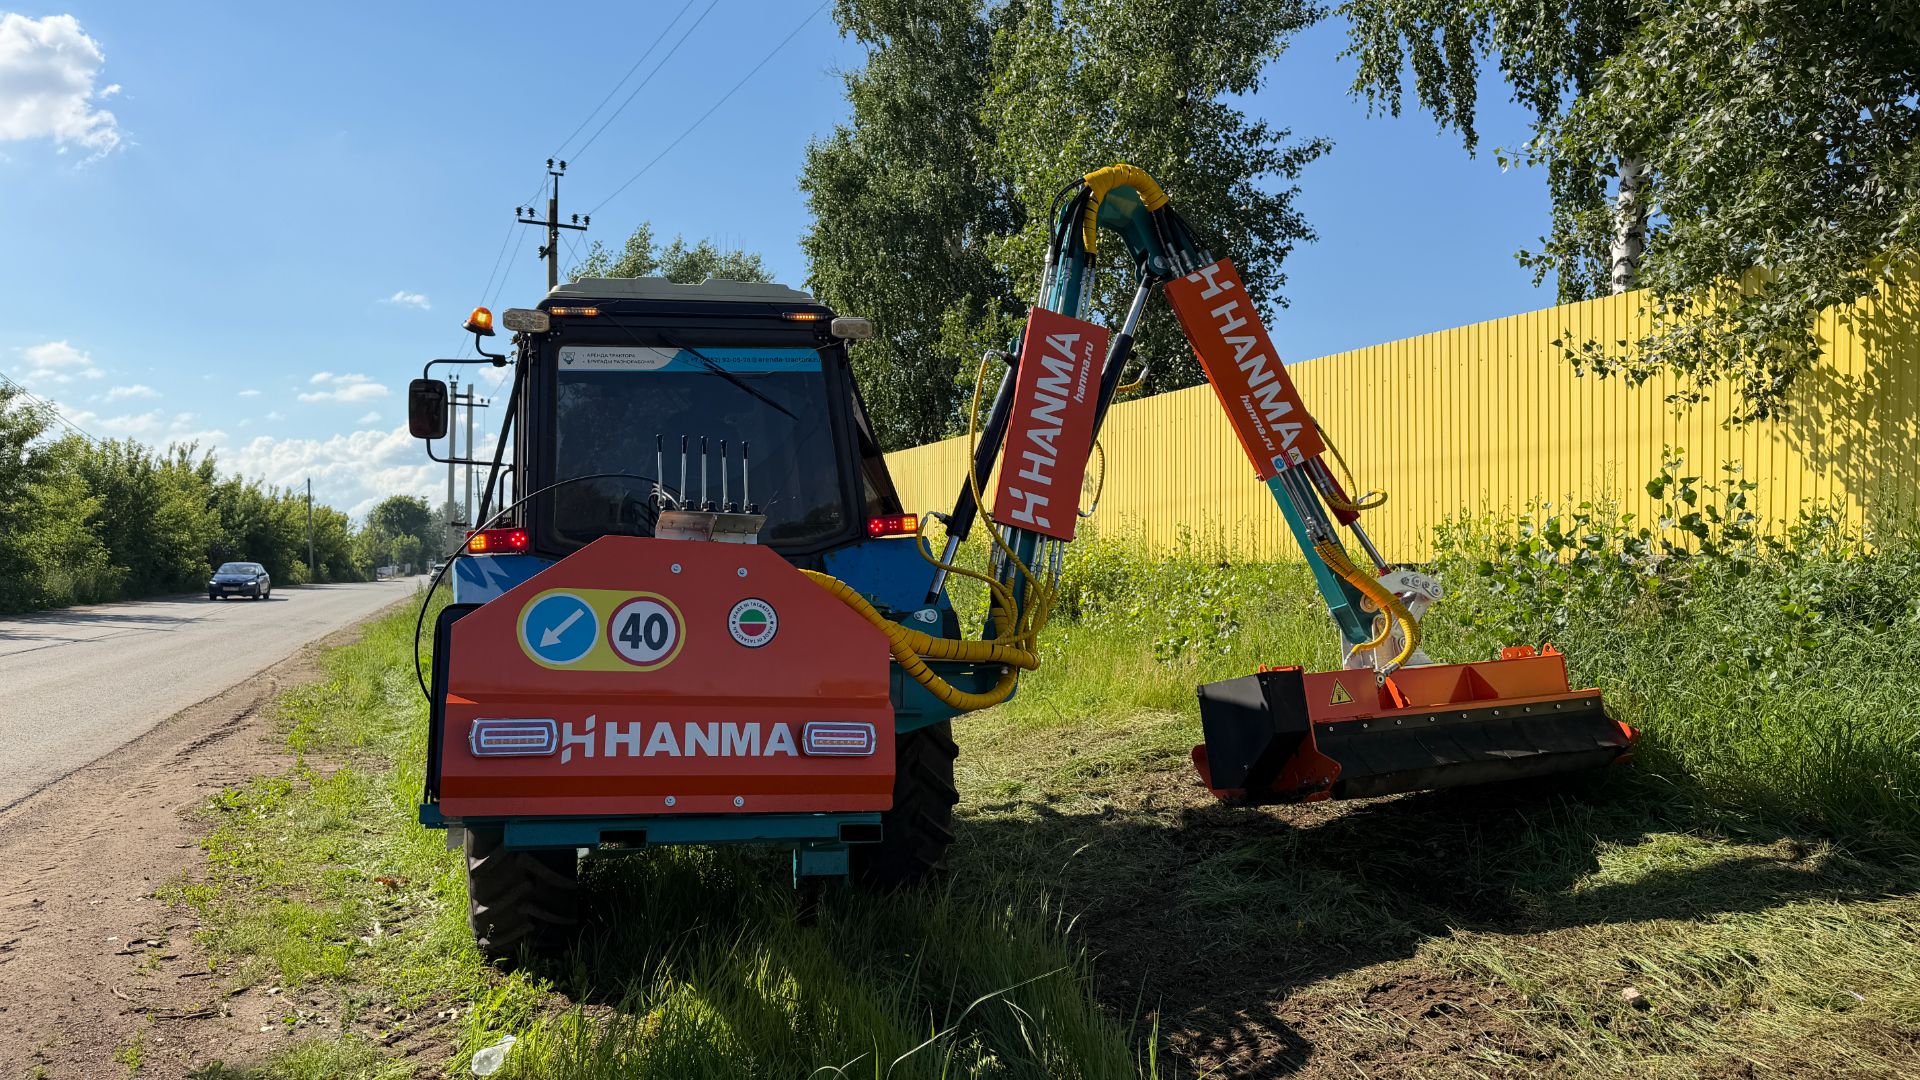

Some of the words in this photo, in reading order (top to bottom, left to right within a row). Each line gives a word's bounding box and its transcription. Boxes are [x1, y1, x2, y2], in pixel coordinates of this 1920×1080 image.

[1073, 341, 1094, 404] hanma.ru
[1210, 300, 1303, 450] HANMA
[1018, 333, 1080, 485] HANMA
[1239, 394, 1275, 451] hanma.ru
[618, 612, 669, 651] 40
[604, 721, 799, 757] HANMA
